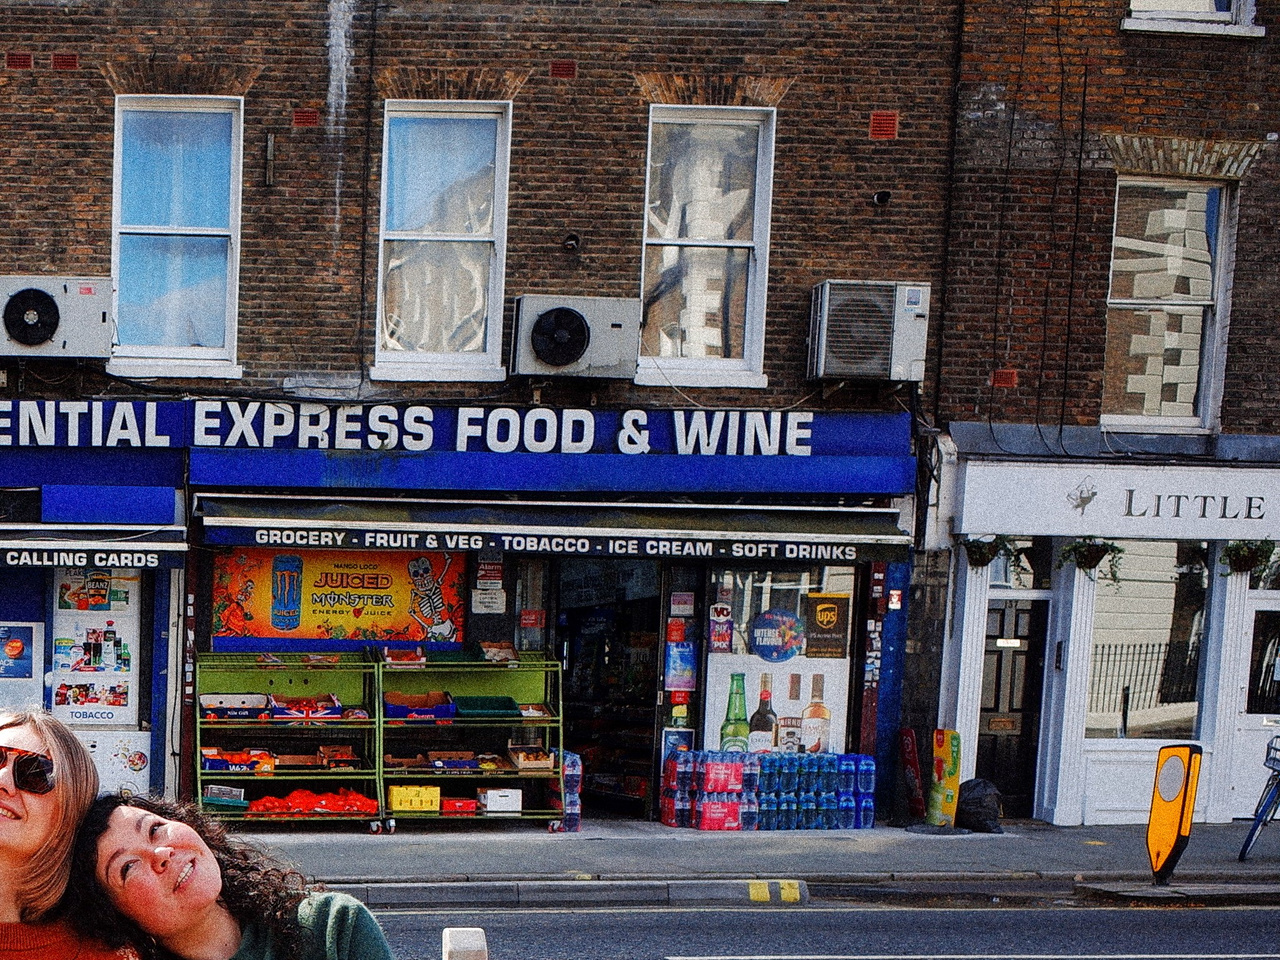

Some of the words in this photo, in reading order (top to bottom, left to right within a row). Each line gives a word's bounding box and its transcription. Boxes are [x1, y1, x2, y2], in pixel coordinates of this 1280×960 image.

[193, 399, 434, 452] EXPRESS
[455, 406, 595, 454] FOOD
[617, 410, 653, 455] &
[672, 410, 814, 457] WINE
[1124, 488, 1266, 520] LITTLE
[255, 529, 345, 547] GROCERY
[365, 531, 420, 548] FRUIT
[425, 532, 438, 548] &
[447, 533, 483, 549] VEG
[501, 535, 590, 553] TOBACCO
[607, 538, 639, 555] ICE
[644, 540, 713, 557] CREAM
[731, 543, 776, 560] SOFT
[783, 544, 857, 561] DRINKS
[6, 552, 88, 567] CALLING
[94, 552, 159, 567] CARDS
[87, 581, 108, 589] BEANZ
[313, 572, 393, 590] JUICED
[312, 591, 395, 608] MONSTER
[818, 611, 836, 625] ups
[70, 711, 114, 720] TOBACCO
